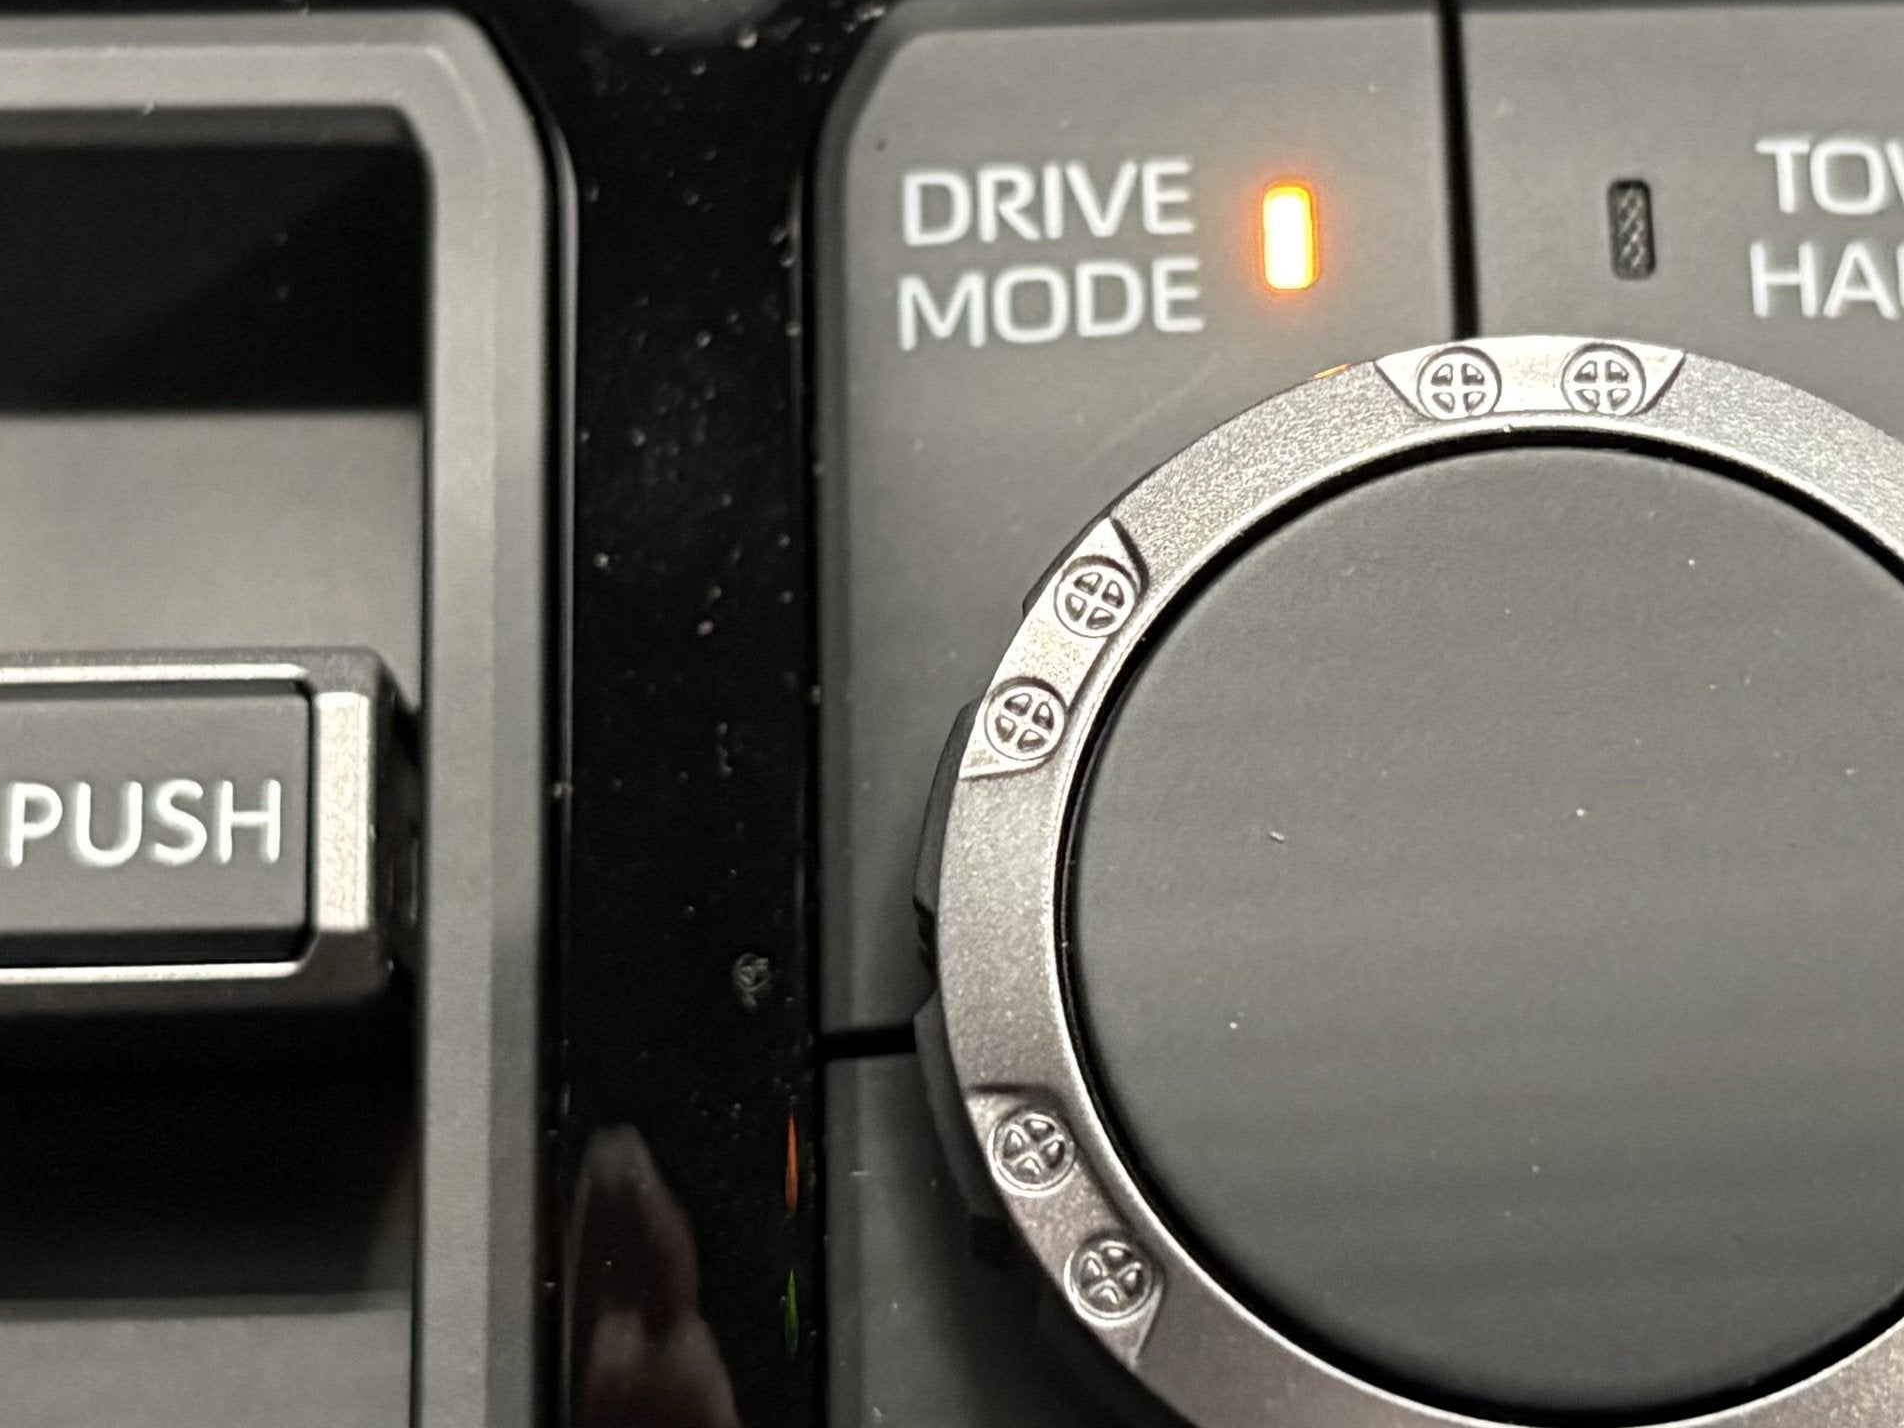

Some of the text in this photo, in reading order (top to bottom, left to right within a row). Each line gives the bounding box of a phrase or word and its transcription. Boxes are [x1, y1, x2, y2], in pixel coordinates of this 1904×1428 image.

[902, 158, 1196, 245] DRIVE
[898, 257, 1205, 351] MODE
[3, 778, 283, 869] PUSH
